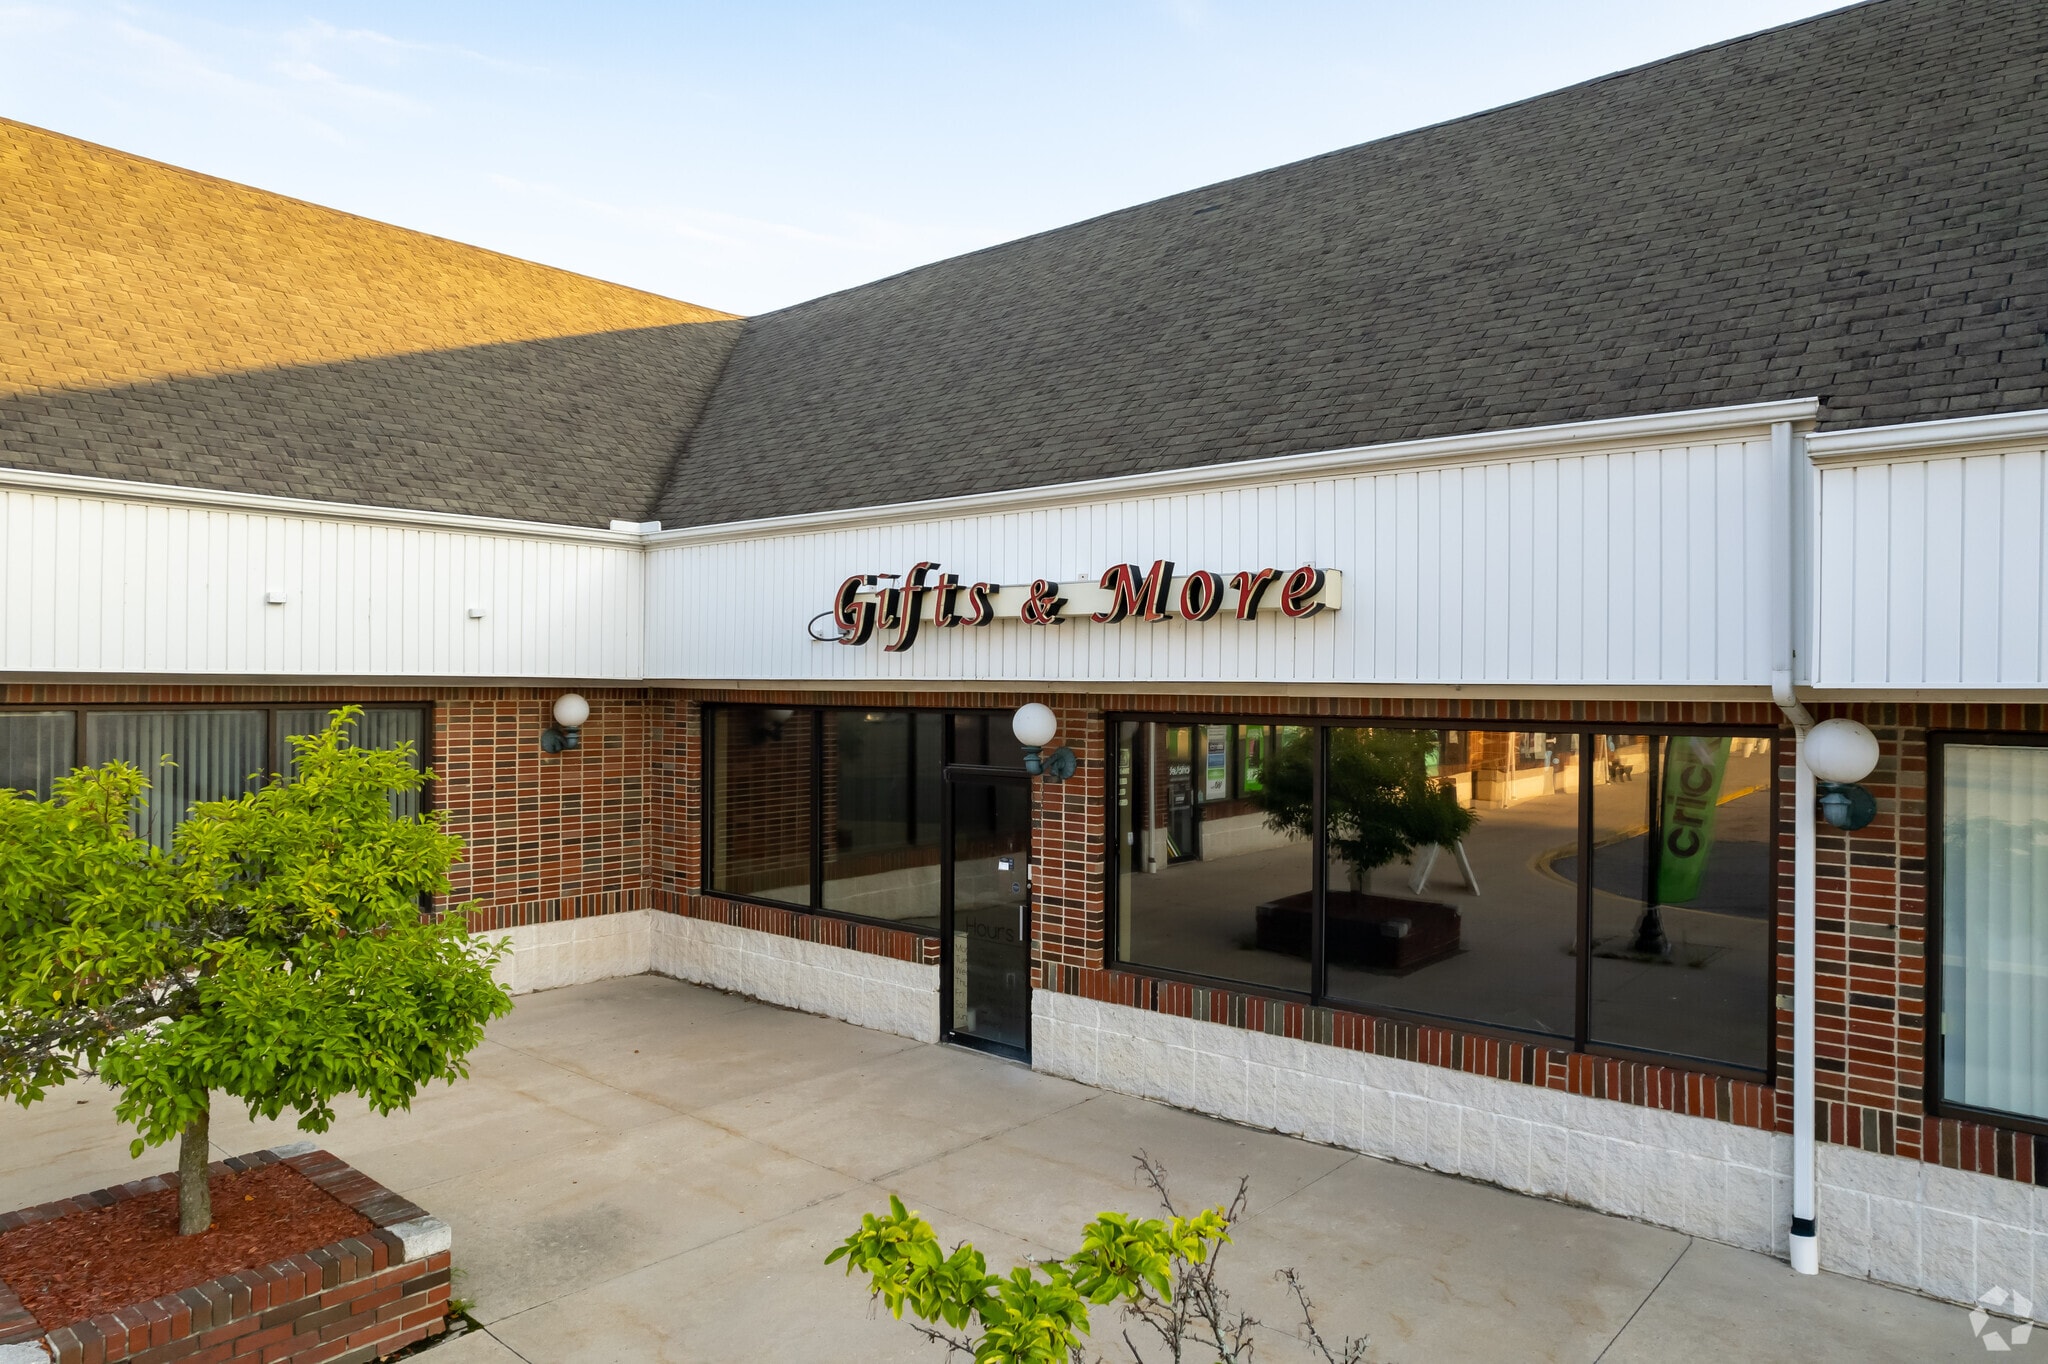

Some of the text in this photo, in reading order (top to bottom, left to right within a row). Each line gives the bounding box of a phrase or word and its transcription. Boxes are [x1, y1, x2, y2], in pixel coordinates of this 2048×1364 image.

[835, 560, 1325, 652] Gifts & More
[966, 916, 1014, 942] Hours
